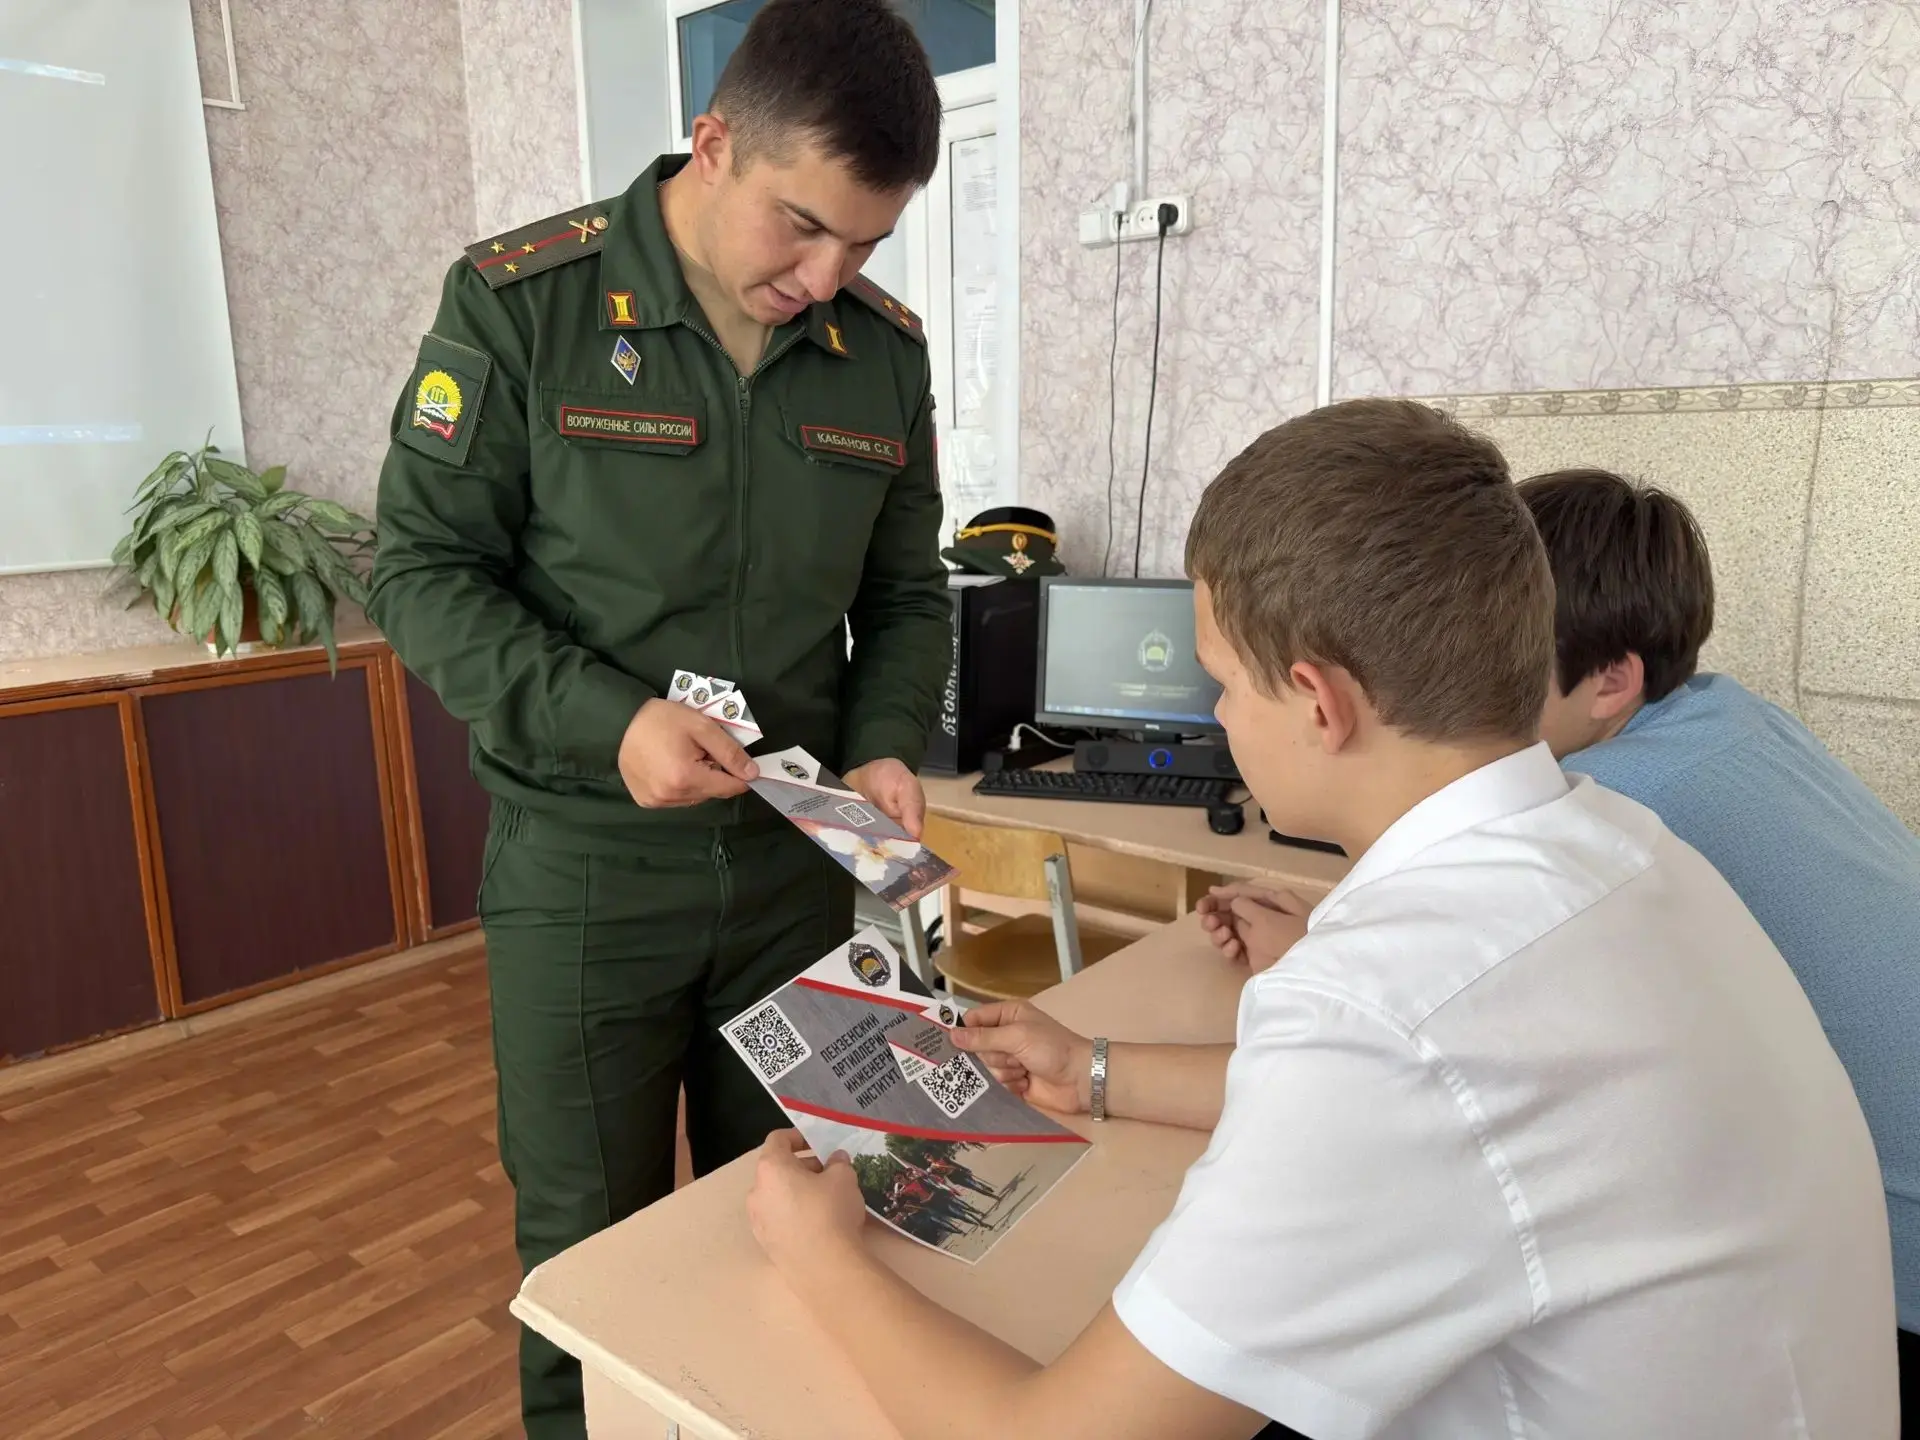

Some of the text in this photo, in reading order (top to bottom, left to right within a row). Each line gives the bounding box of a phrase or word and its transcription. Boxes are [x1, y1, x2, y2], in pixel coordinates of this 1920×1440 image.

[567, 415, 692, 437] ВООРУЖЕННЫЕ СИЛЫ РОССИИ
[817, 432, 871, 452] КАБАНОВ
[820, 1013, 881, 1064] ПЕНЗЕНСКИЙ
[843, 1048, 896, 1095] ИНЖЕНЕРН
[856, 1067, 901, 1110] ИНСТИТУТ
